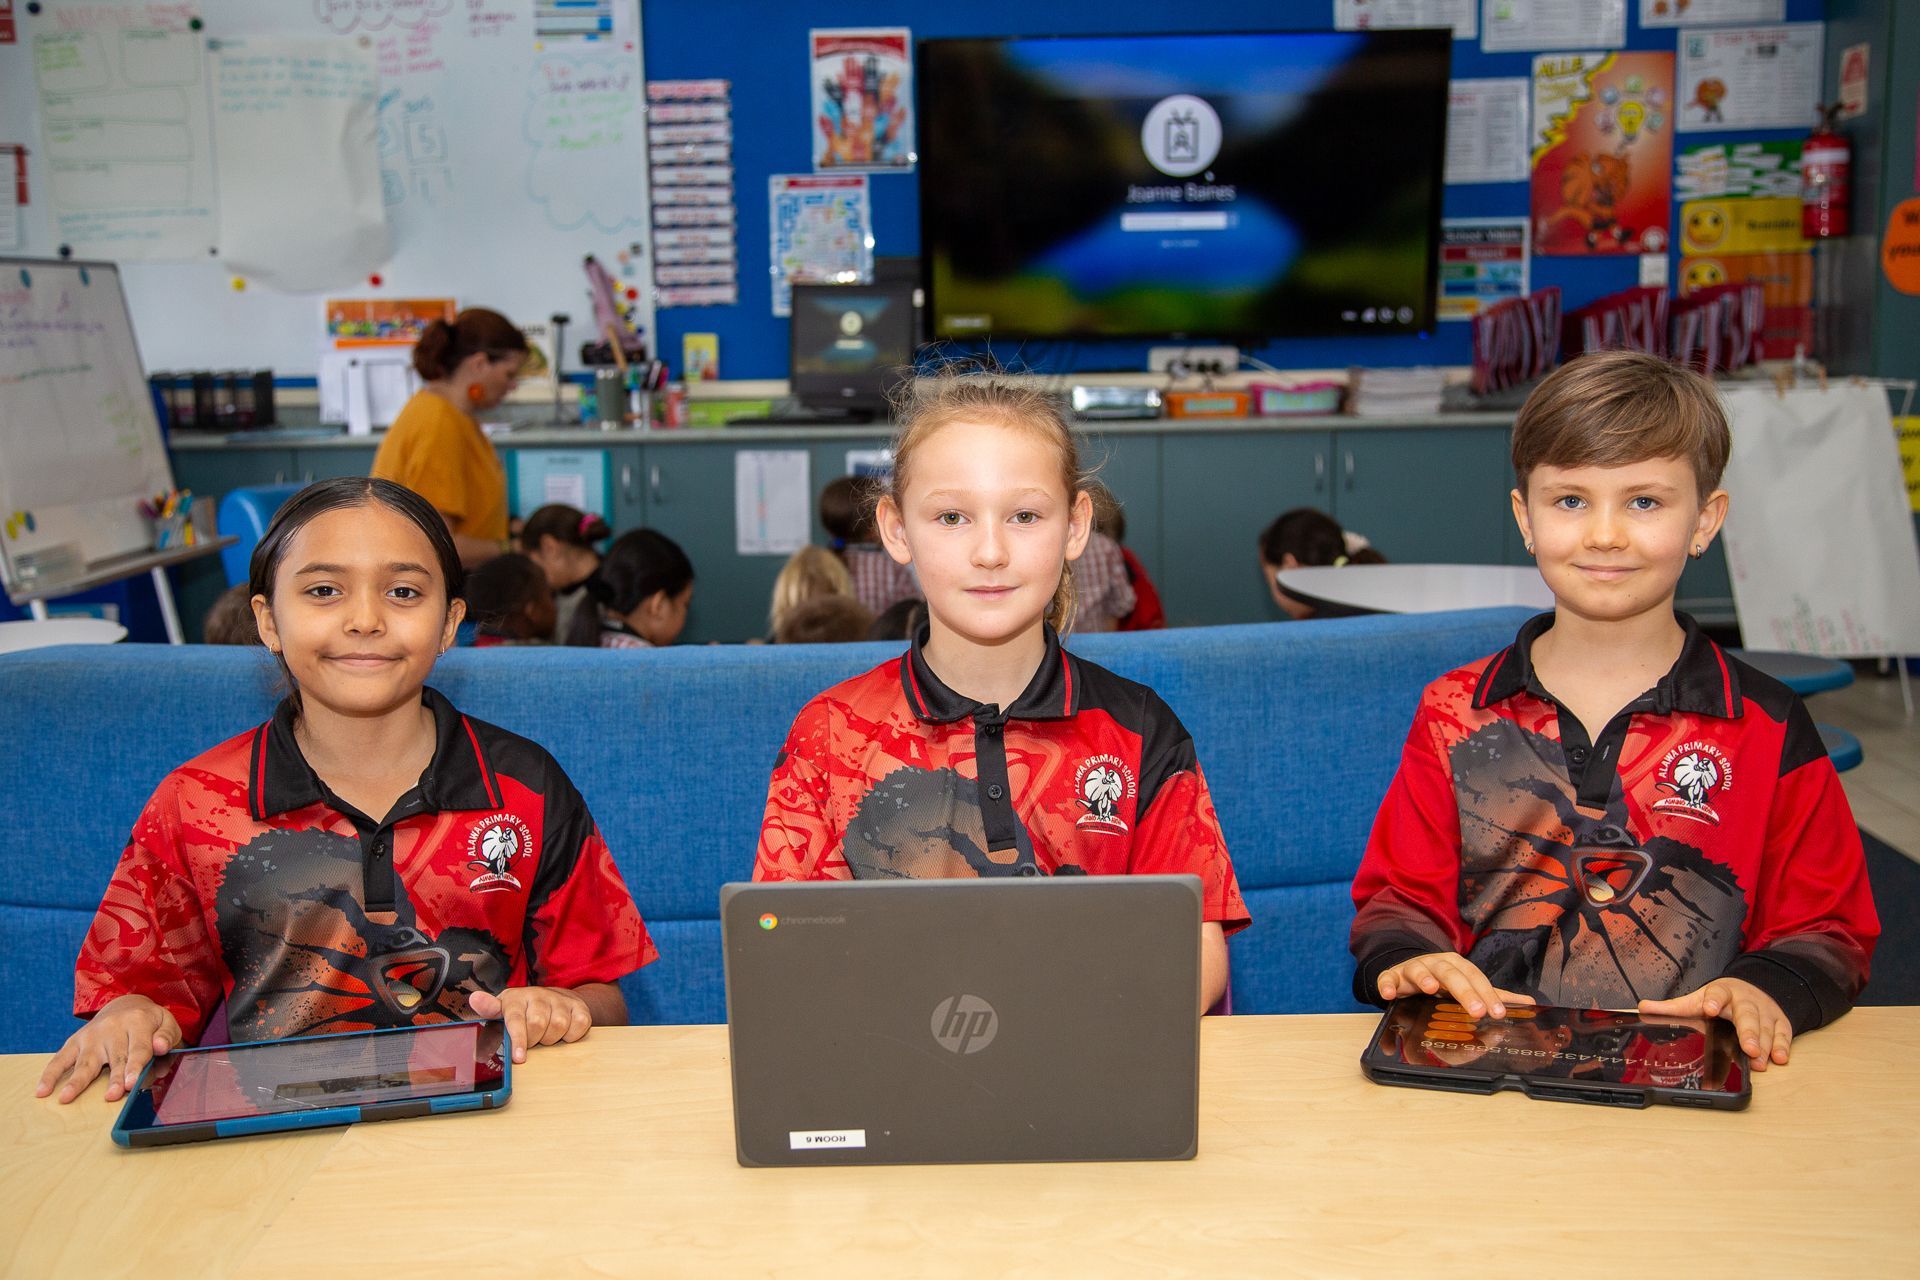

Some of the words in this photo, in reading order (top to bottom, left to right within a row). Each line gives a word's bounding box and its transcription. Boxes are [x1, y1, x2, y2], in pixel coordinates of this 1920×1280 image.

[1126, 184, 1183, 203] Joanne
[1074, 764, 1087, 795] ALAWA
[1085, 753, 1124, 768] PRIMARY
[1121, 765, 1137, 799] SCHOOL
[1658, 749, 1679, 778] ALAWA
[1677, 741, 1722, 758] PRIMARY
[1718, 757, 1733, 791] SCHOOL
[467, 826, 482, 857] ALAWA
[479, 813, 522, 829] PRIMARY
[519, 824, 533, 858] SCHOOL
[781, 914, 846, 925] chromebook
[935, 994, 994, 1054] hp
[814, 1135, 846, 1143] ROOM
